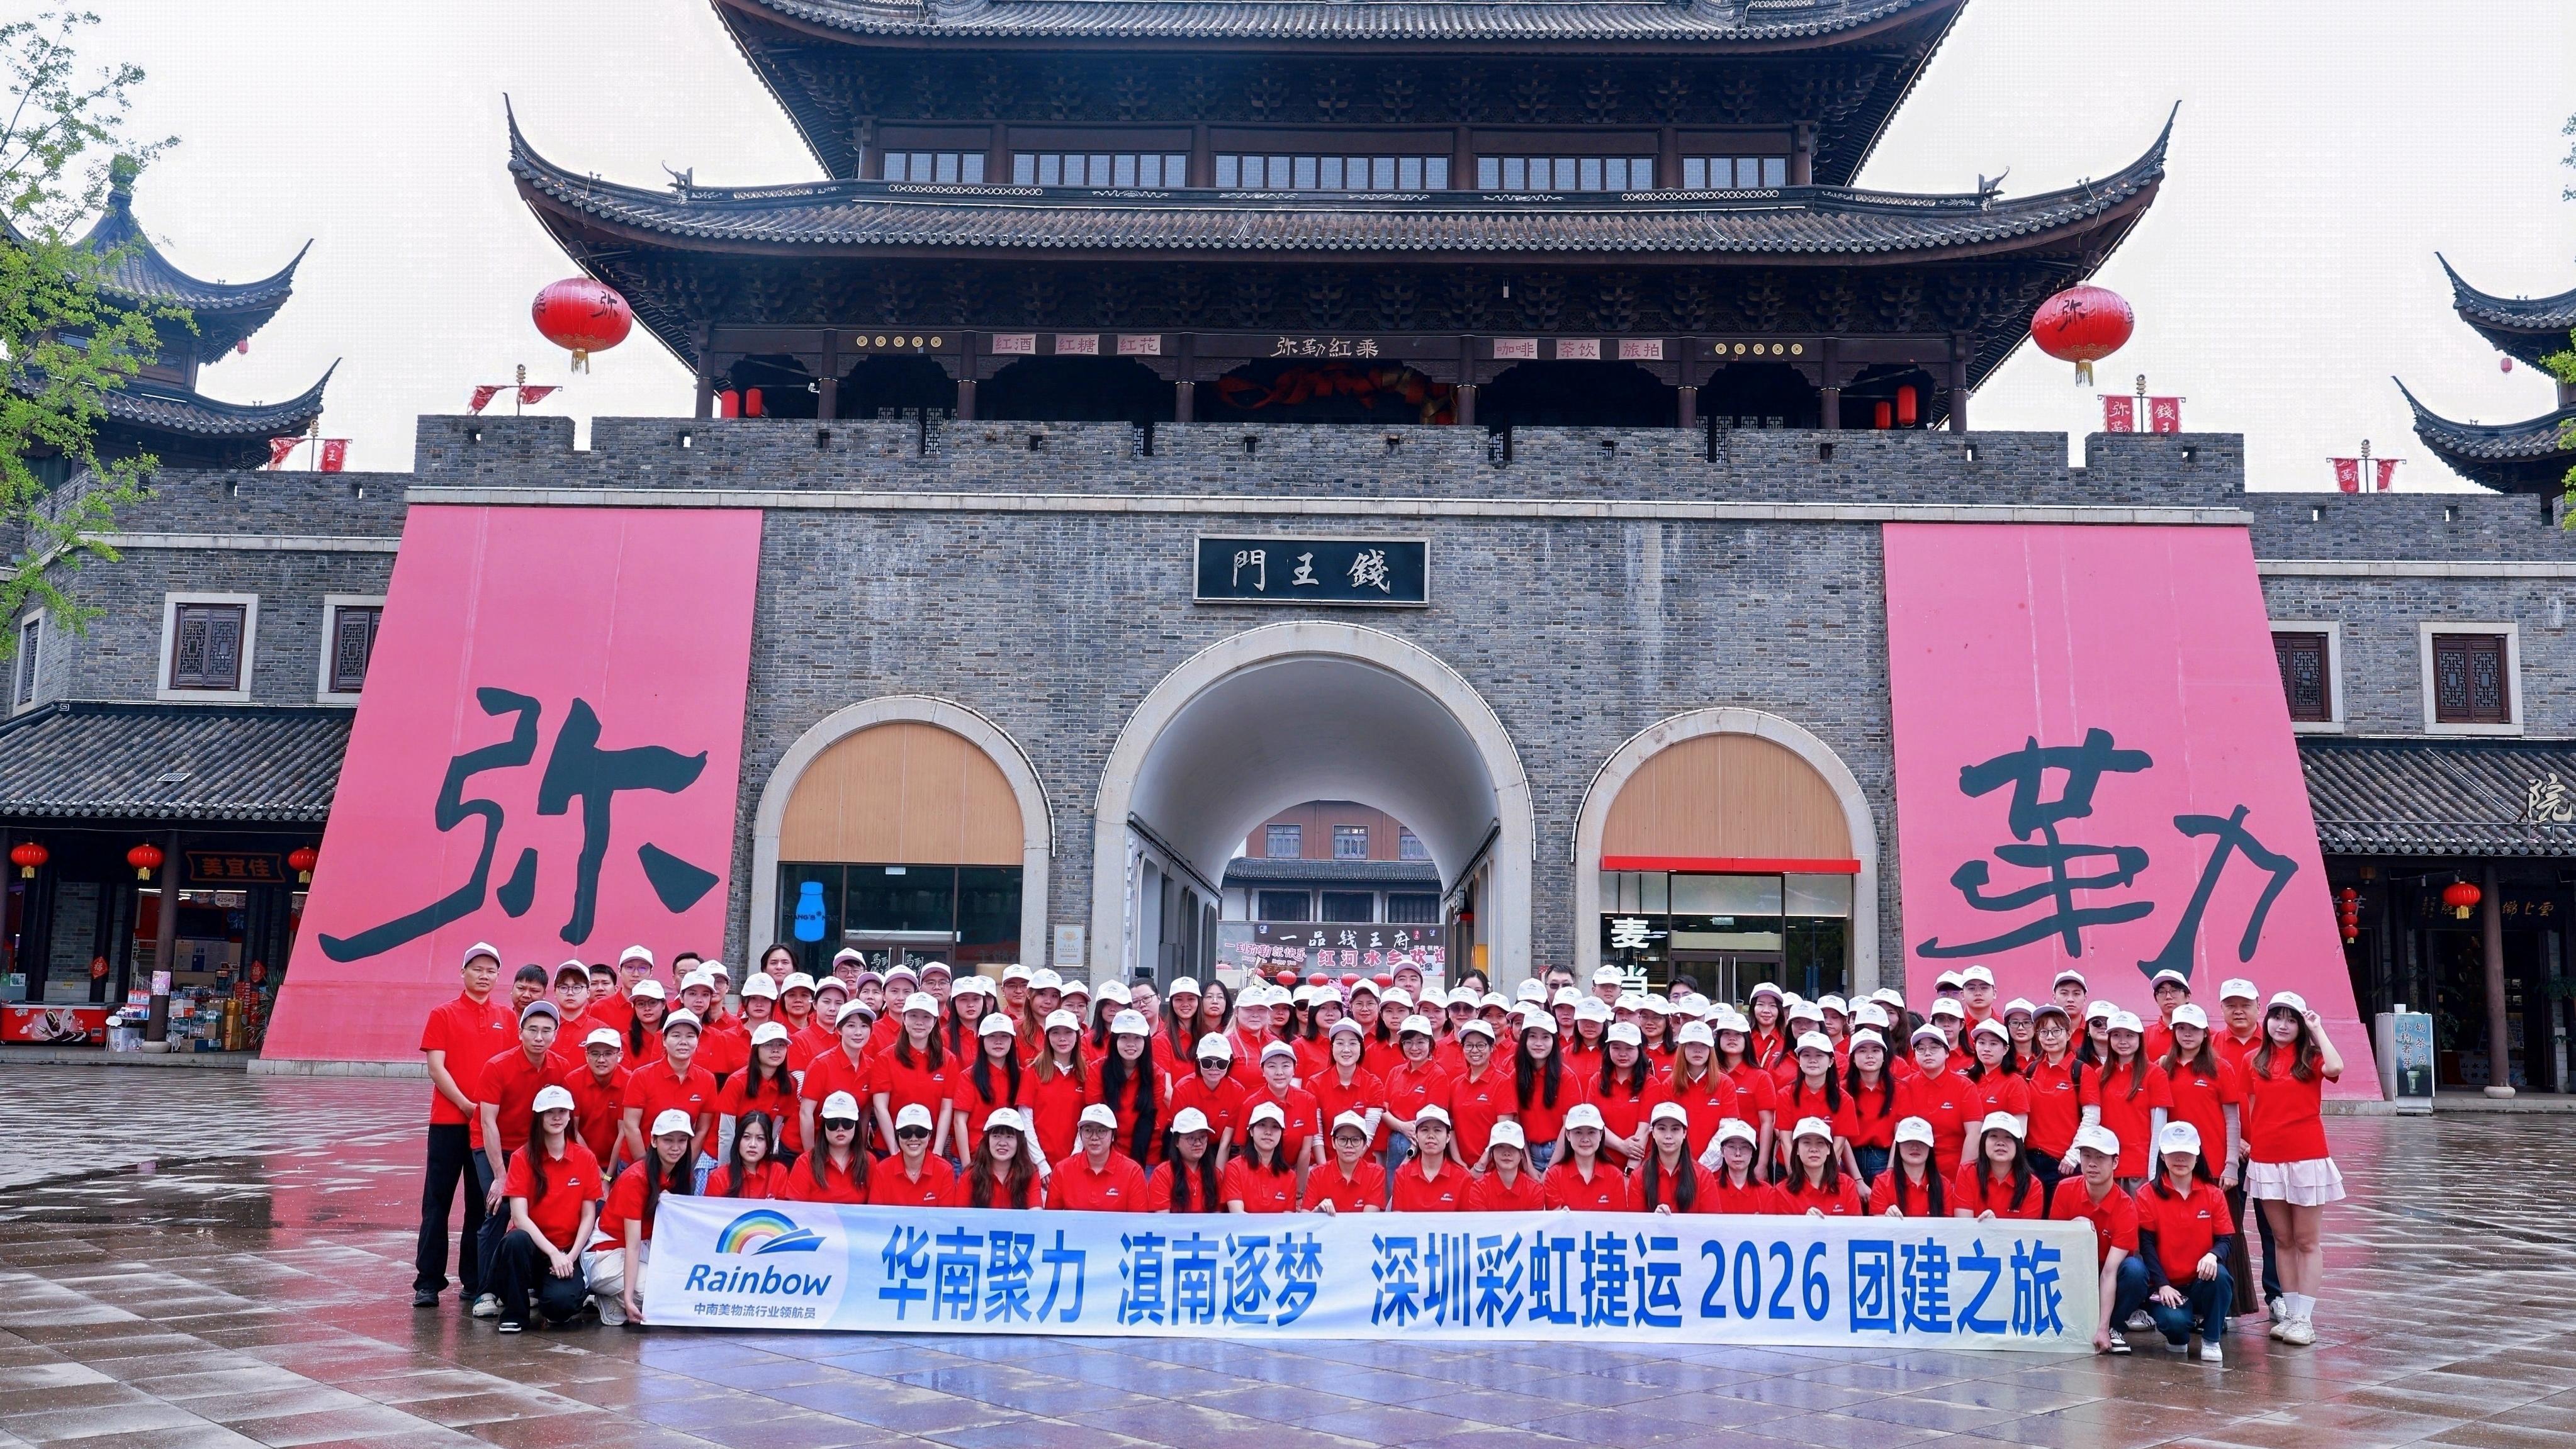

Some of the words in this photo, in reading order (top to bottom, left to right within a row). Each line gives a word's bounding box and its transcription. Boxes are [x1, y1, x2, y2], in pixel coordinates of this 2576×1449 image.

[590, 291, 619, 319] 弥
[2057, 299, 2086, 332] 弥
[996, 337, 1032, 351] 红酒
[1059, 338, 1096, 352] 红糖
[1120, 337, 1158, 353] 红花
[1497, 342, 1534, 357] 咖啡
[1560, 342, 1596, 357] 茶饮
[1623, 343, 1659, 357] 旅拍
[318, 686, 720, 963] 弥
[1916, 727, 2299, 980] 勒
[201, 858, 271, 876] 美宜佳
[1224, 942, 1307, 962] 一到弥勒就快乐
[2416, 1022, 2427, 1065] 奶茶店
[684, 1264, 832, 1297] Rainbow
[880, 1224, 1087, 1323] 华南聚力
[1117, 1231, 1322, 1328] 滇南逐梦
[1371, 1231, 1682, 1328] 深圳彩虹捷运
[1700, 1239, 1830, 1322] 2026
[1848, 1238, 2063, 1335] 团建之旅
[694, 1302, 816, 1319] 中南美物流行业领航员
